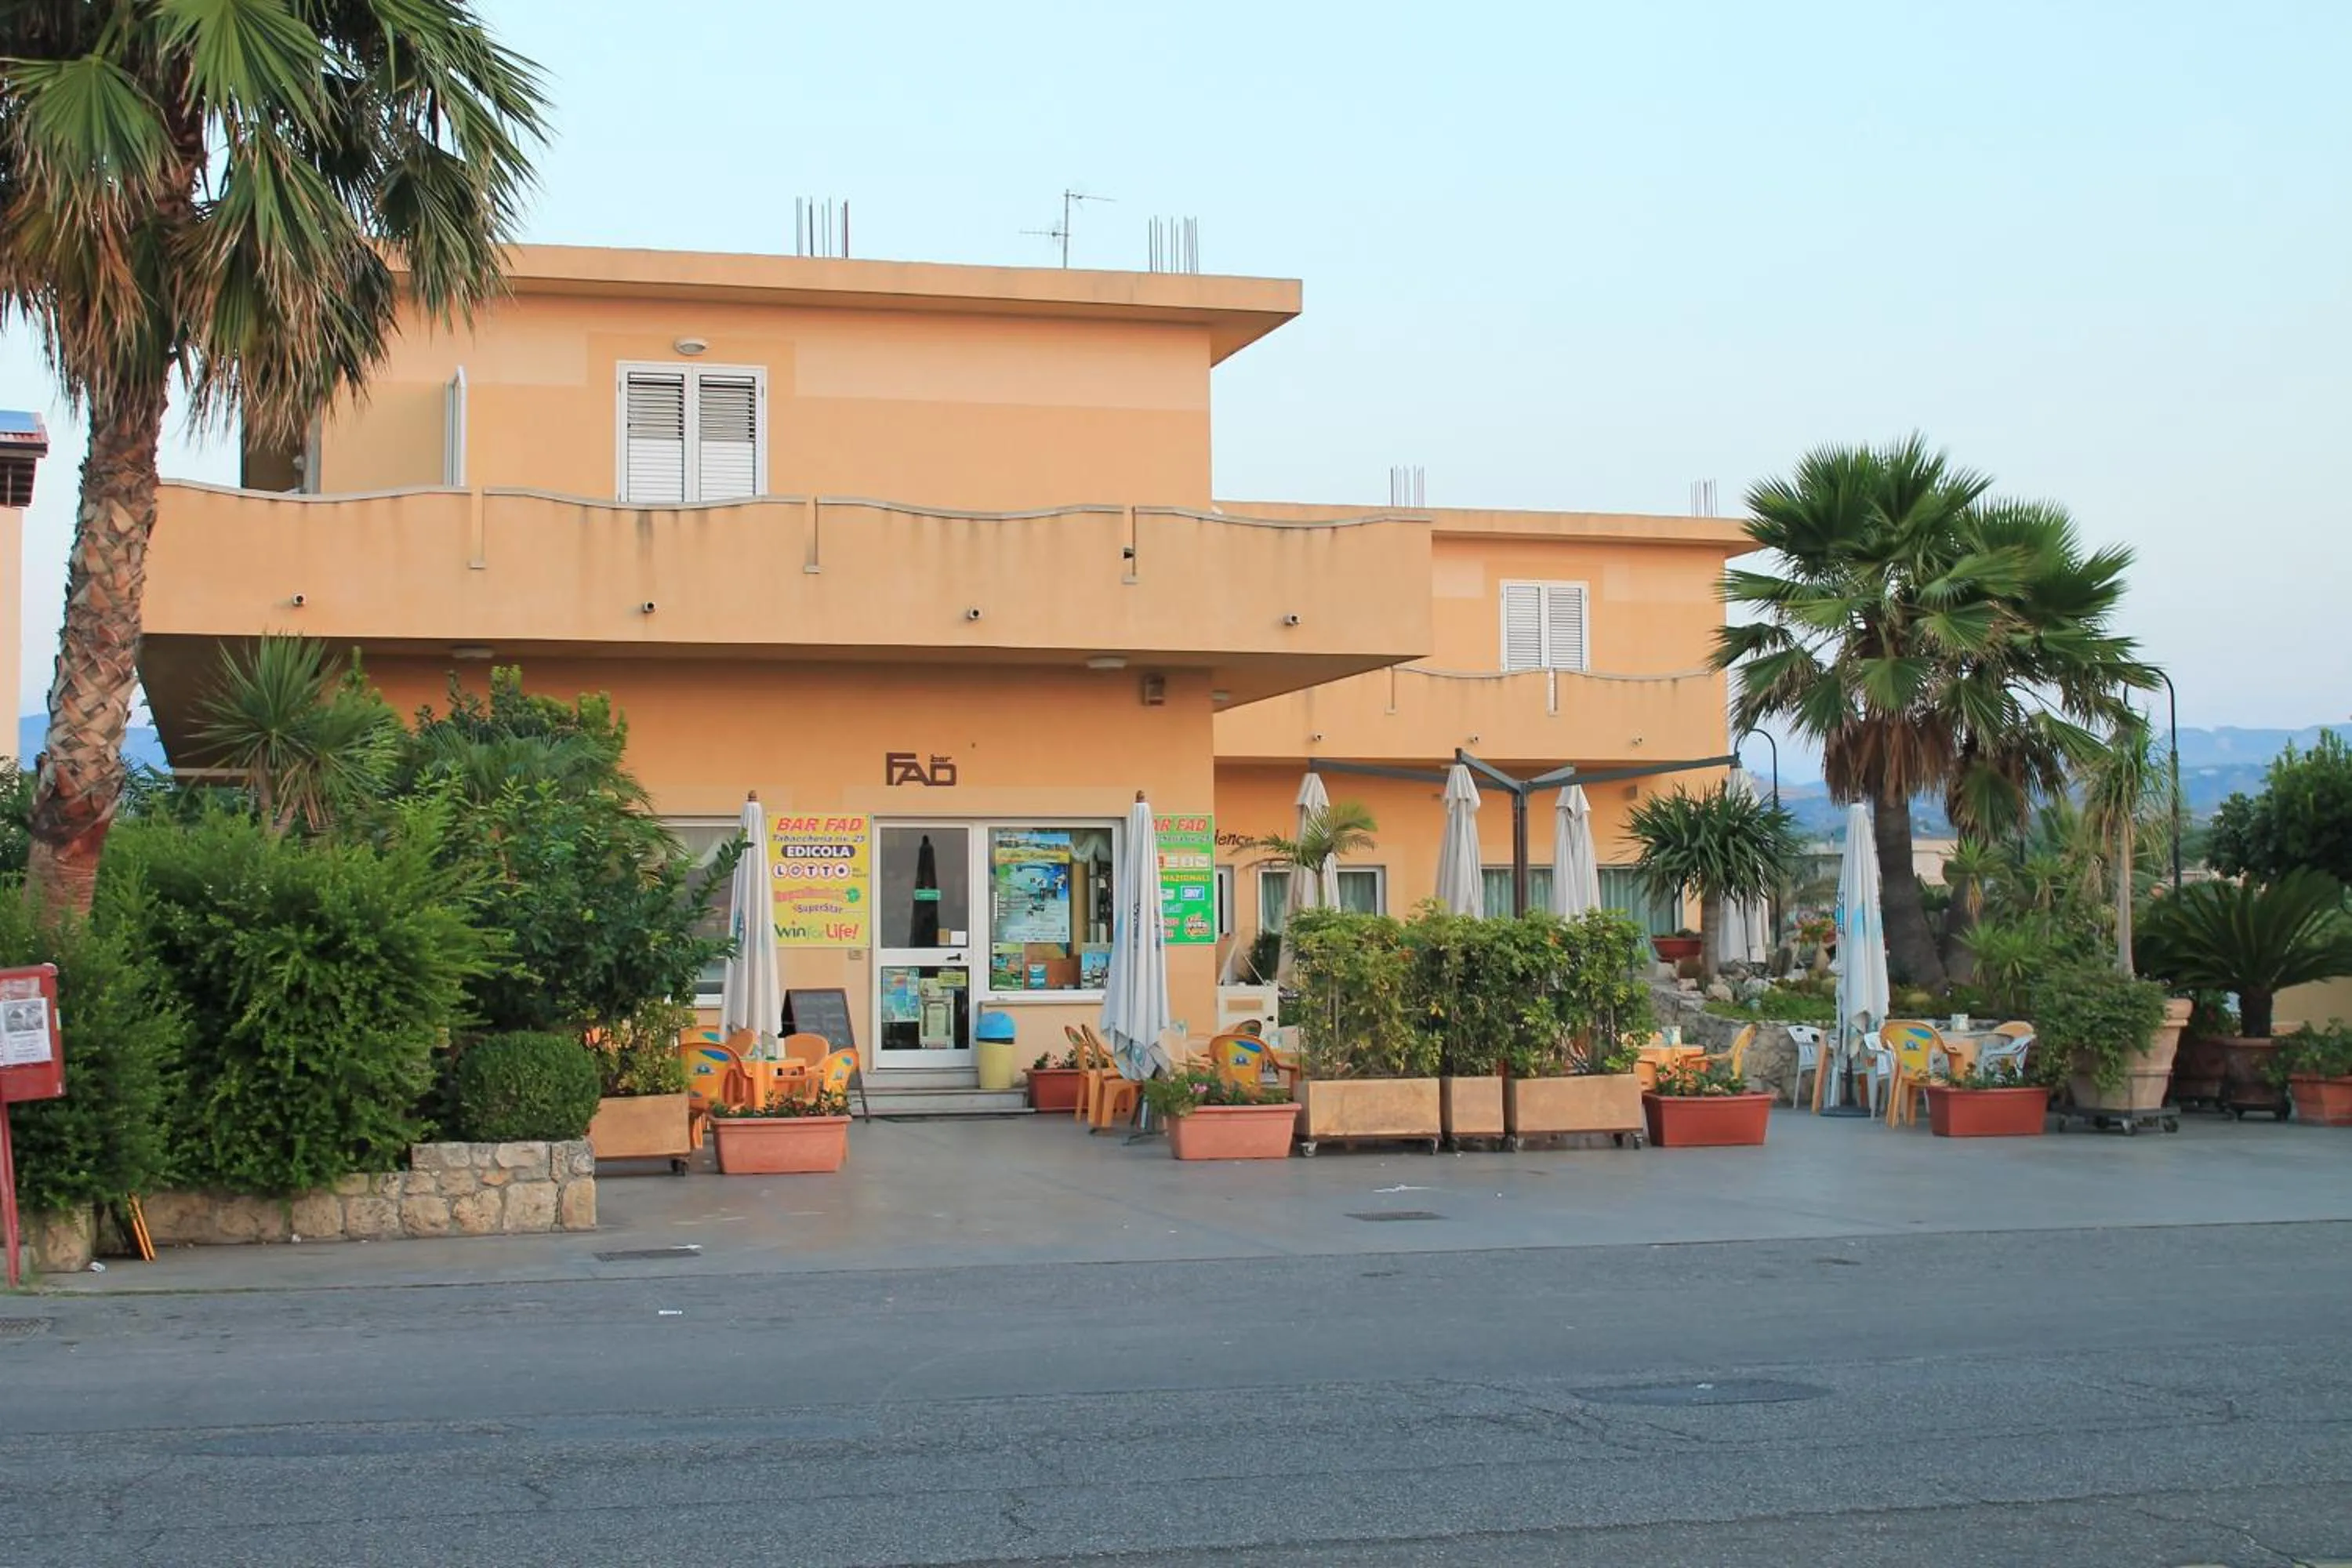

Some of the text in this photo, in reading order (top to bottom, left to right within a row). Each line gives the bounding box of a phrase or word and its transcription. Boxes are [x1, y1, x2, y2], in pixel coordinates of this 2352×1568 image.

[931, 754, 952, 763] bar
[886, 752, 956, 786] FAD
[776, 818, 864, 832] BAR FAD
[1154, 818, 1207, 831] AR FAD
[786, 846, 851, 857] EDICOLA
[772, 862, 850, 878] LOTTO
[774, 920, 806, 938] Win
[826, 923, 859, 940] Life!
